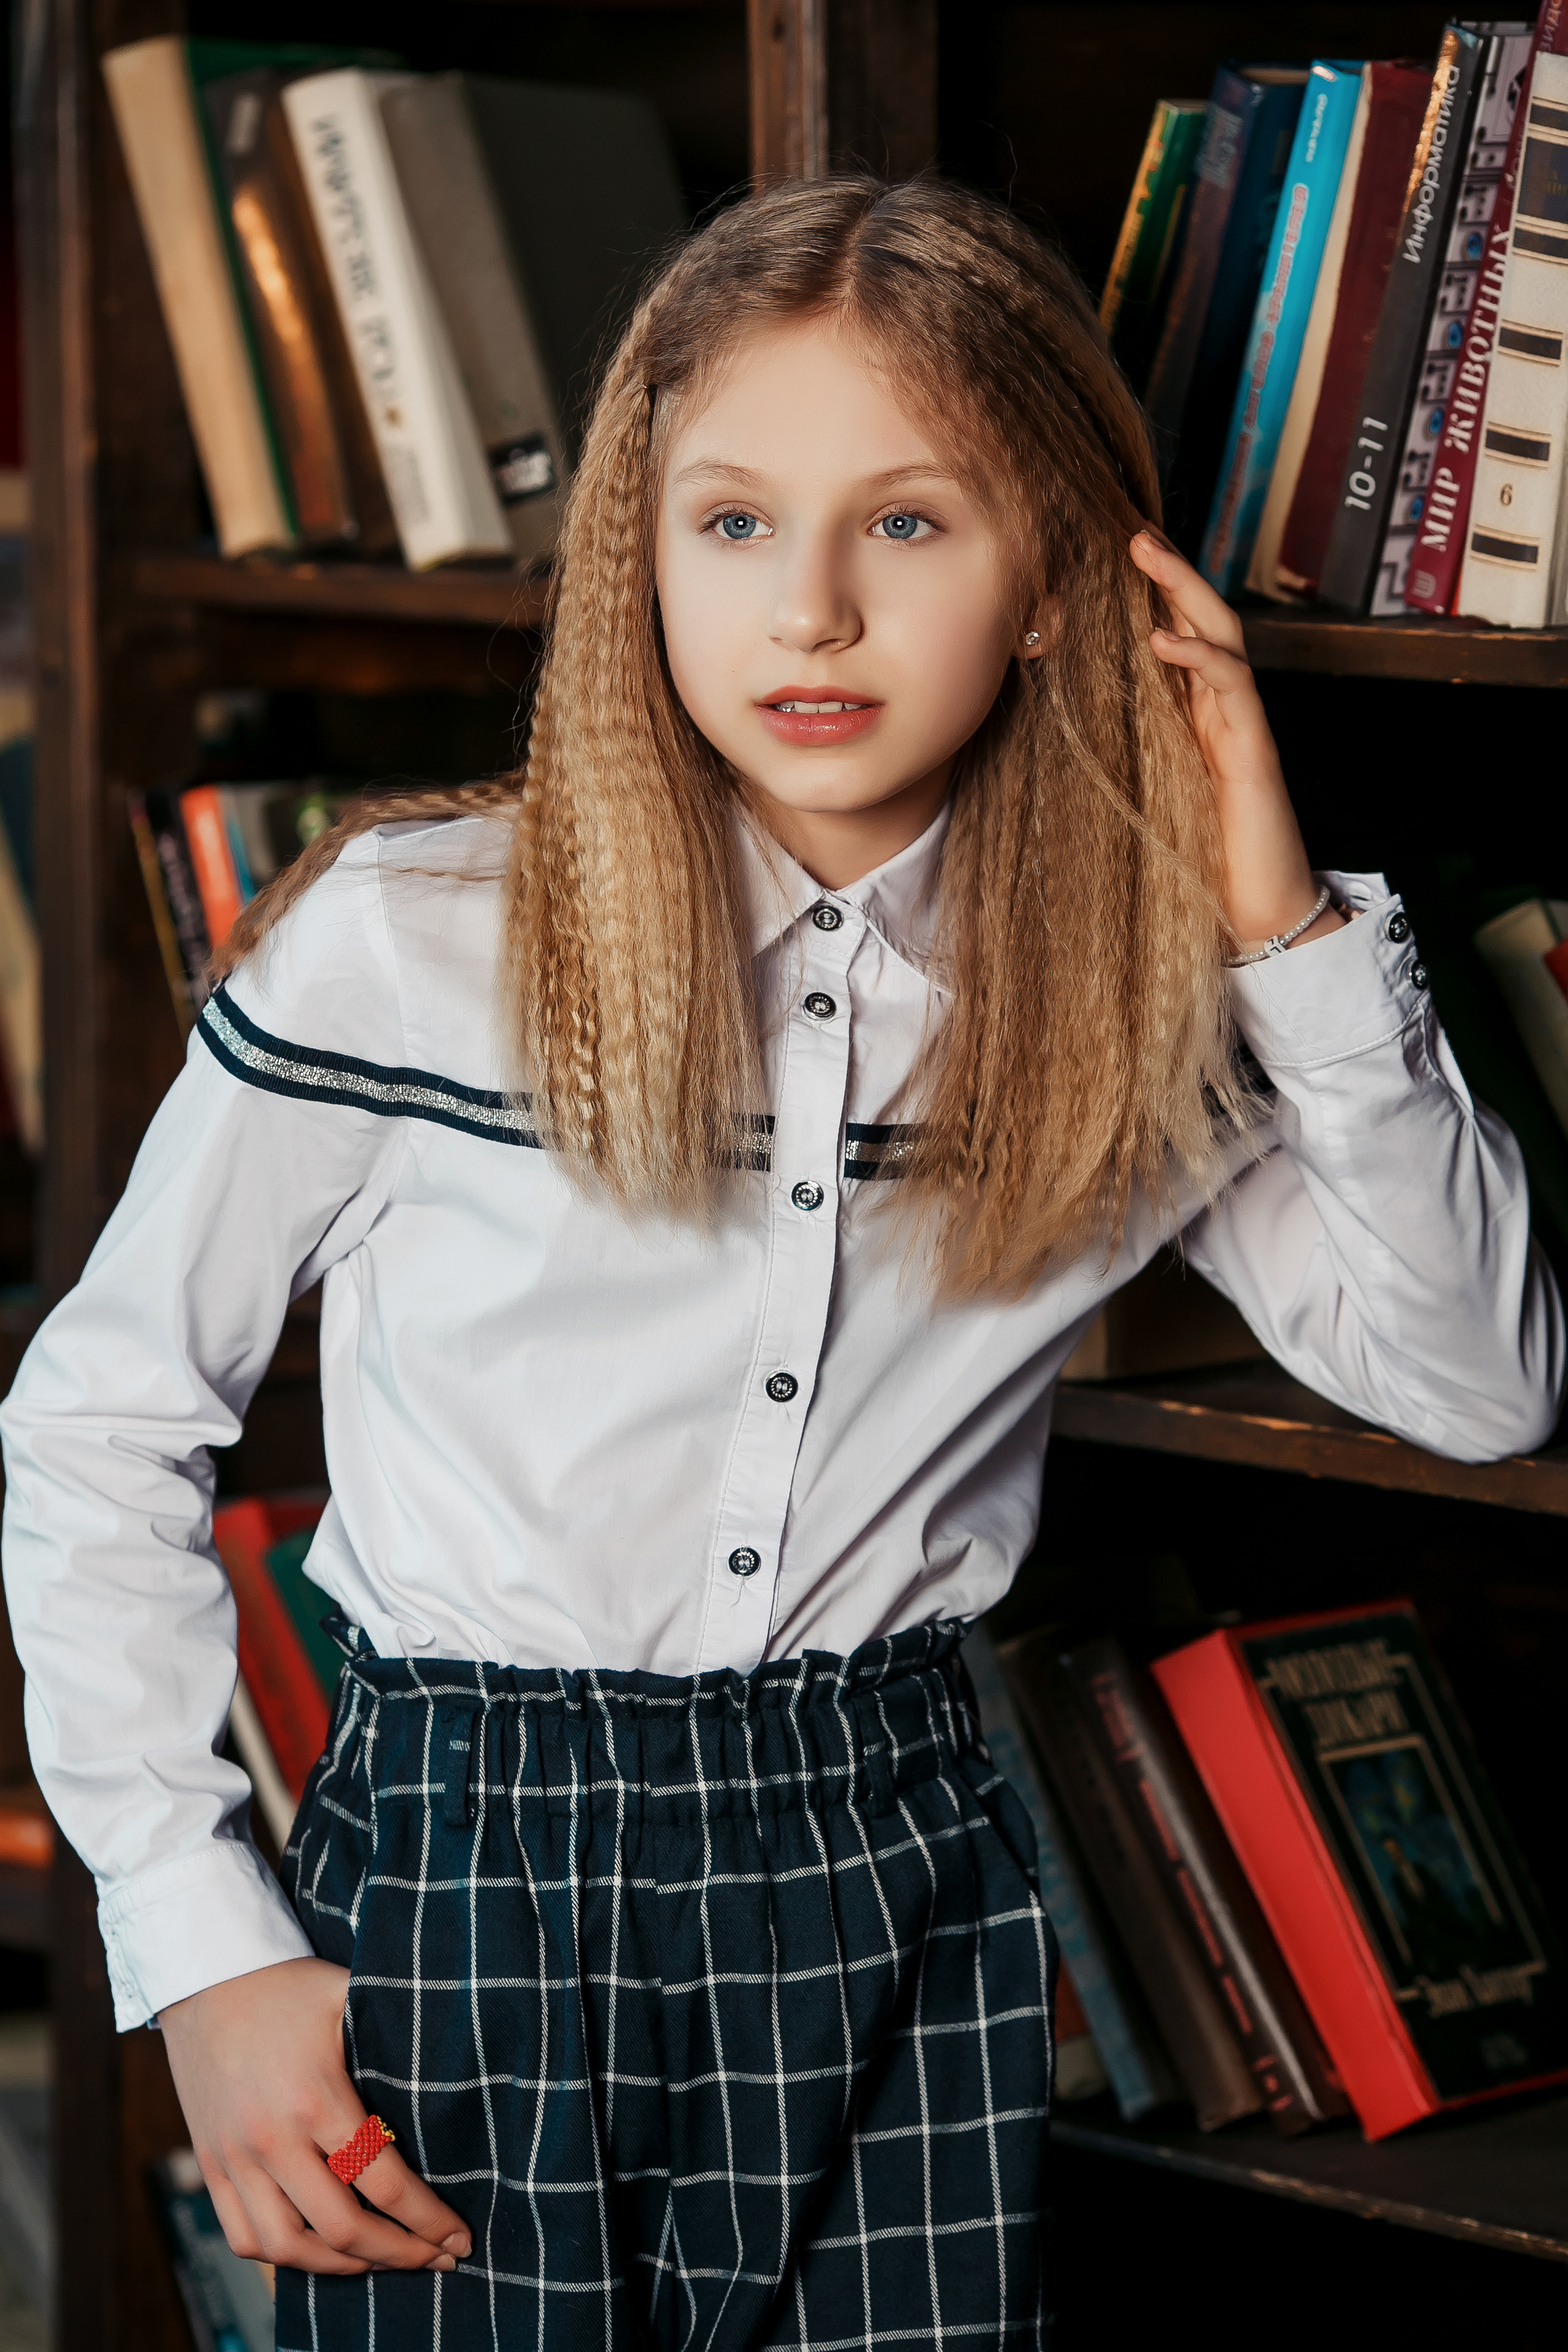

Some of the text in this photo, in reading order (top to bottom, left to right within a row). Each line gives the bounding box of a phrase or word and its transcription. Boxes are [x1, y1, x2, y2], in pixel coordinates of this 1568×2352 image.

[1402, 65, 1460, 264] Информатика
[1420, 466, 1460, 552] МИР
[1443, 222, 1510, 454] ЖИВОТНЫХ
[1344, 417, 1389, 511] 10-11
[1500, 483, 1513, 506] 6
